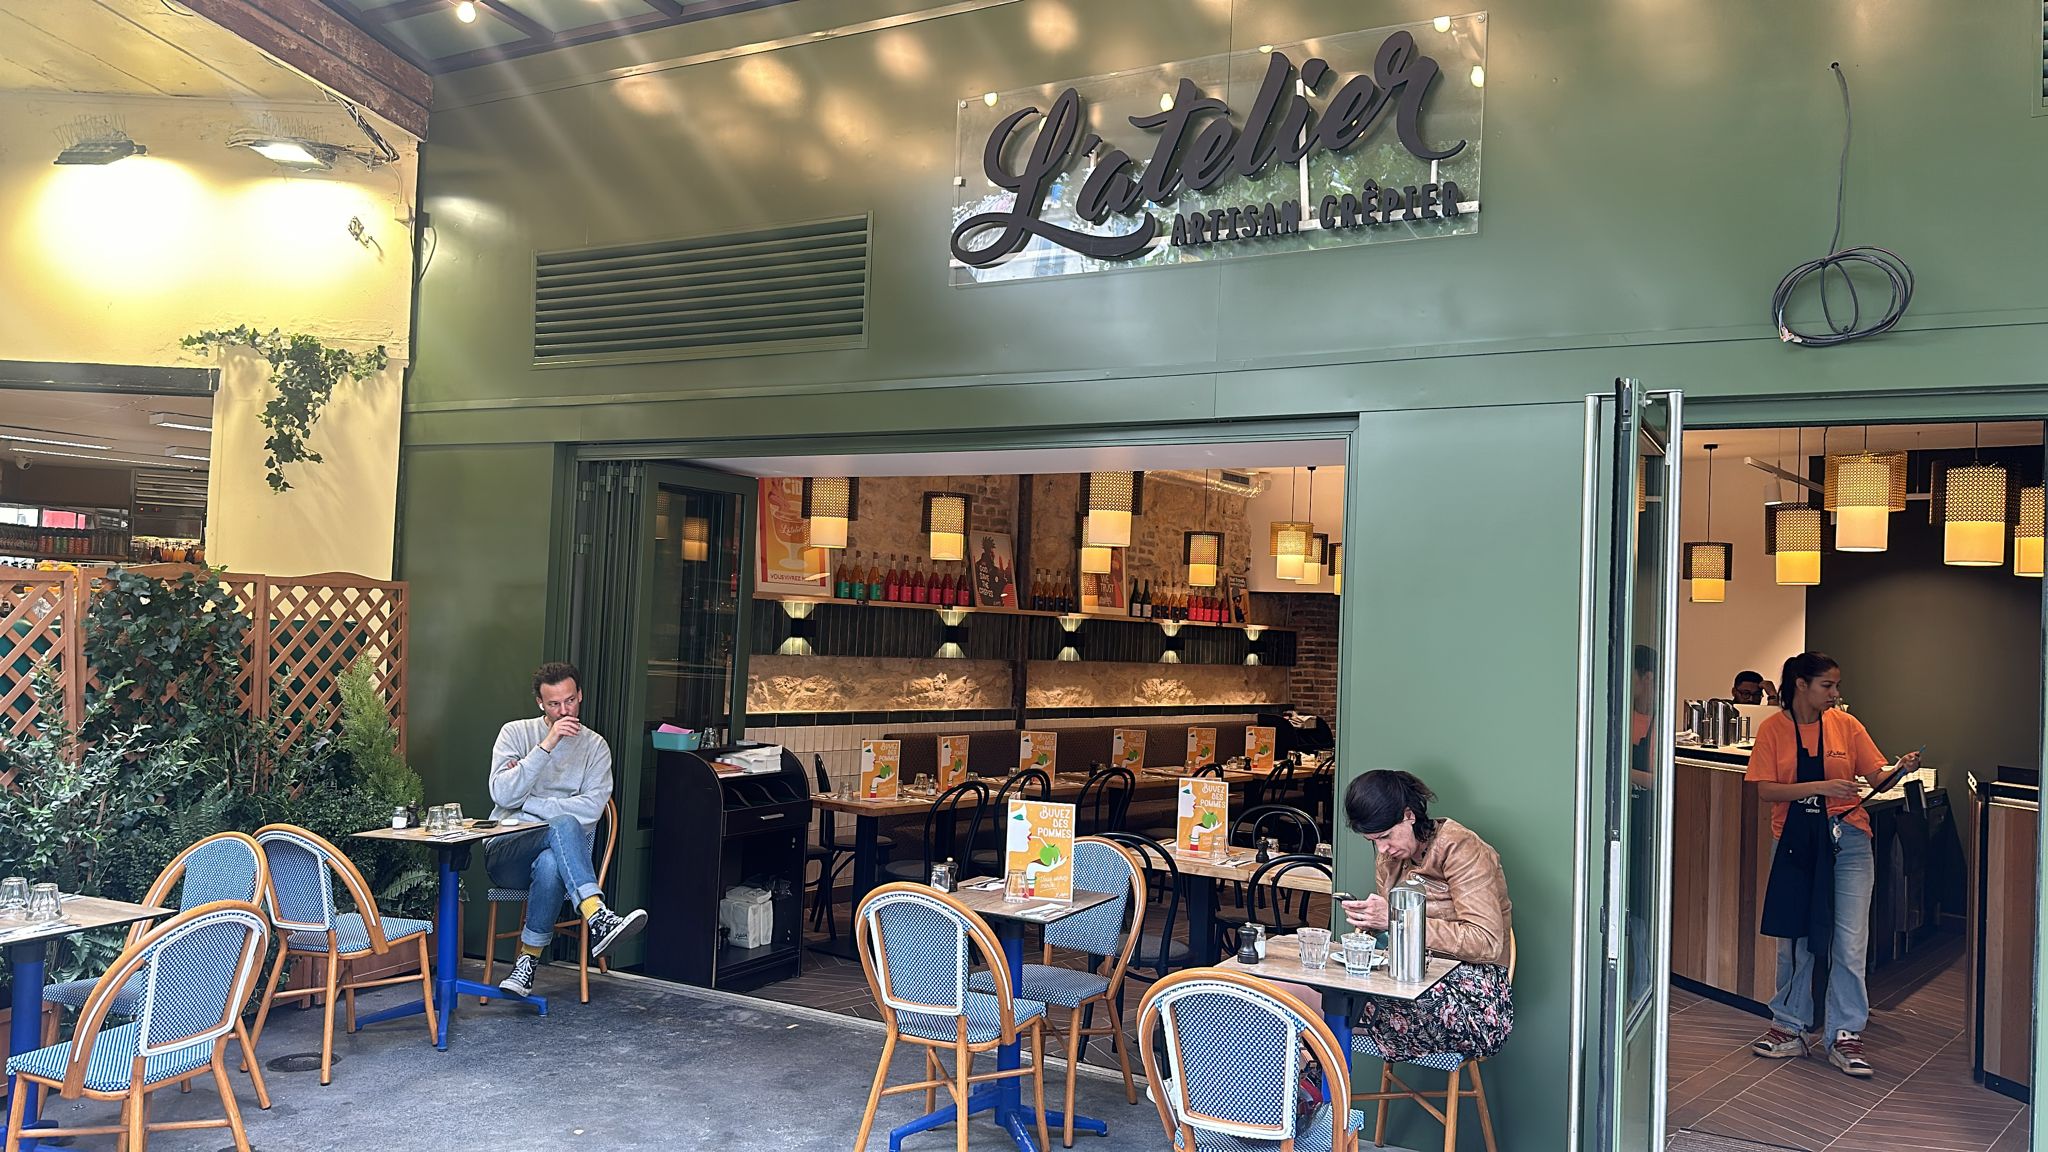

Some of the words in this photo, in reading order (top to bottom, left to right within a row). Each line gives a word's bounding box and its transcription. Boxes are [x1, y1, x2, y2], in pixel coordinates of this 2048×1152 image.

[951, 31, 1466, 268] L'atelier
[1171, 200, 1299, 246] ARTISAN
[1319, 178, 1459, 229] CRÊPIER
[1202, 782, 1225, 794] BUVEZ
[1211, 793, 1224, 801] DES
[1200, 799, 1226, 809] POMMES
[1039, 805, 1071, 819] BUVEZ
[1052, 818, 1069, 828] DES
[1037, 827, 1072, 839] POMMES
